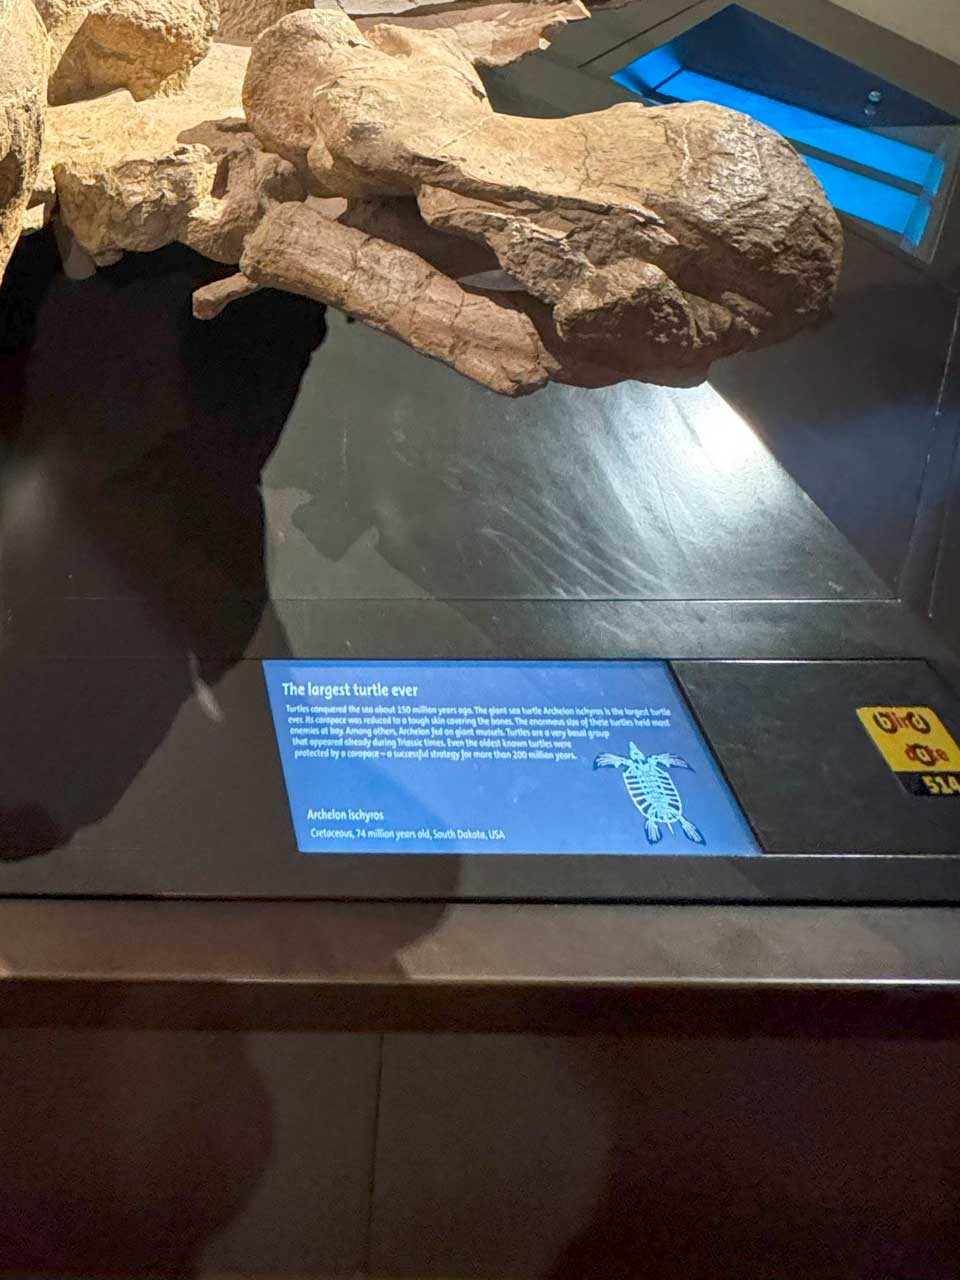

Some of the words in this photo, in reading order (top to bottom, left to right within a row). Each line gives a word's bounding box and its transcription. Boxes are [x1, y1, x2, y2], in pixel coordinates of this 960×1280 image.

[282, 682, 305, 695] The
[308, 682, 351, 699] largest
[353, 683, 389, 696] turtle
[391, 686, 418, 696] ever
[307, 809, 347, 819] Archelon
[348, 809, 384, 823] ischyros
[310, 828, 355, 839] Cretaceous,
[355, 829, 366, 838] 74
[367, 828, 394, 838] million
[395, 831, 417, 841] years
[417, 829, 432, 840] old,
[433, 829, 456, 839] South
[457, 829, 488, 840] Dakota,
[488, 830, 506, 839] USA
